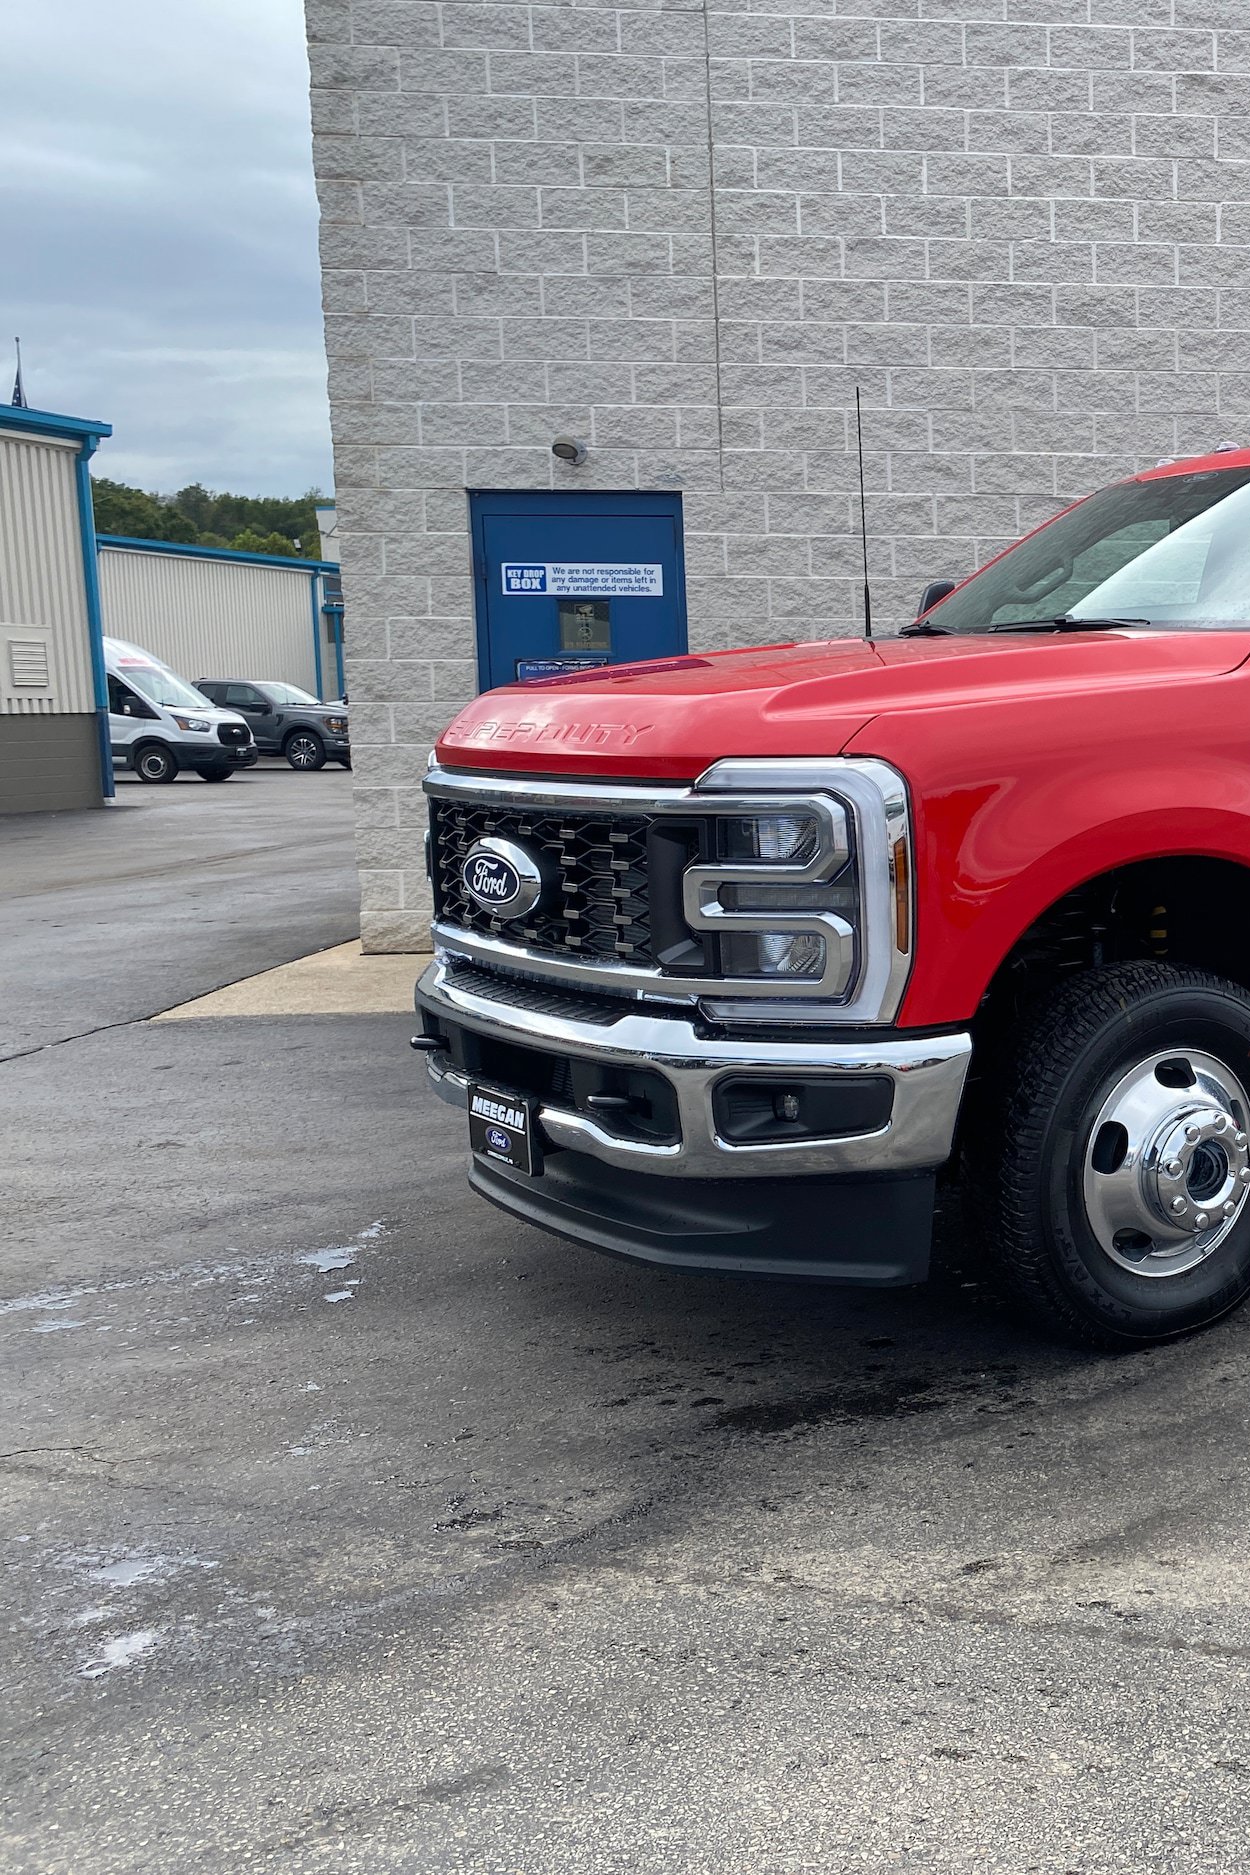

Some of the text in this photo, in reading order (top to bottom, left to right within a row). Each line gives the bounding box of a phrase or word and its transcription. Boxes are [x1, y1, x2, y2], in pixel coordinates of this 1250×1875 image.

[507, 569, 545, 578] KEY DROP
[552, 567, 566, 575] We
[596, 568, 641, 577] responsible
[643, 568, 655, 576] for
[510, 578, 542, 590] BOX
[567, 576, 599, 585] damage
[611, 576, 633, 584] items
[634, 576, 648, 584] left
[649, 576, 657, 584] in
[556, 585, 571, 593] any
[618, 585, 652, 593] vehicles.
[536, 723, 656, 746] DUTY
[472, 858, 508, 897] Ford
[471, 1095, 525, 1130] MEEGAN
[490, 1129, 507, 1148] Ford
